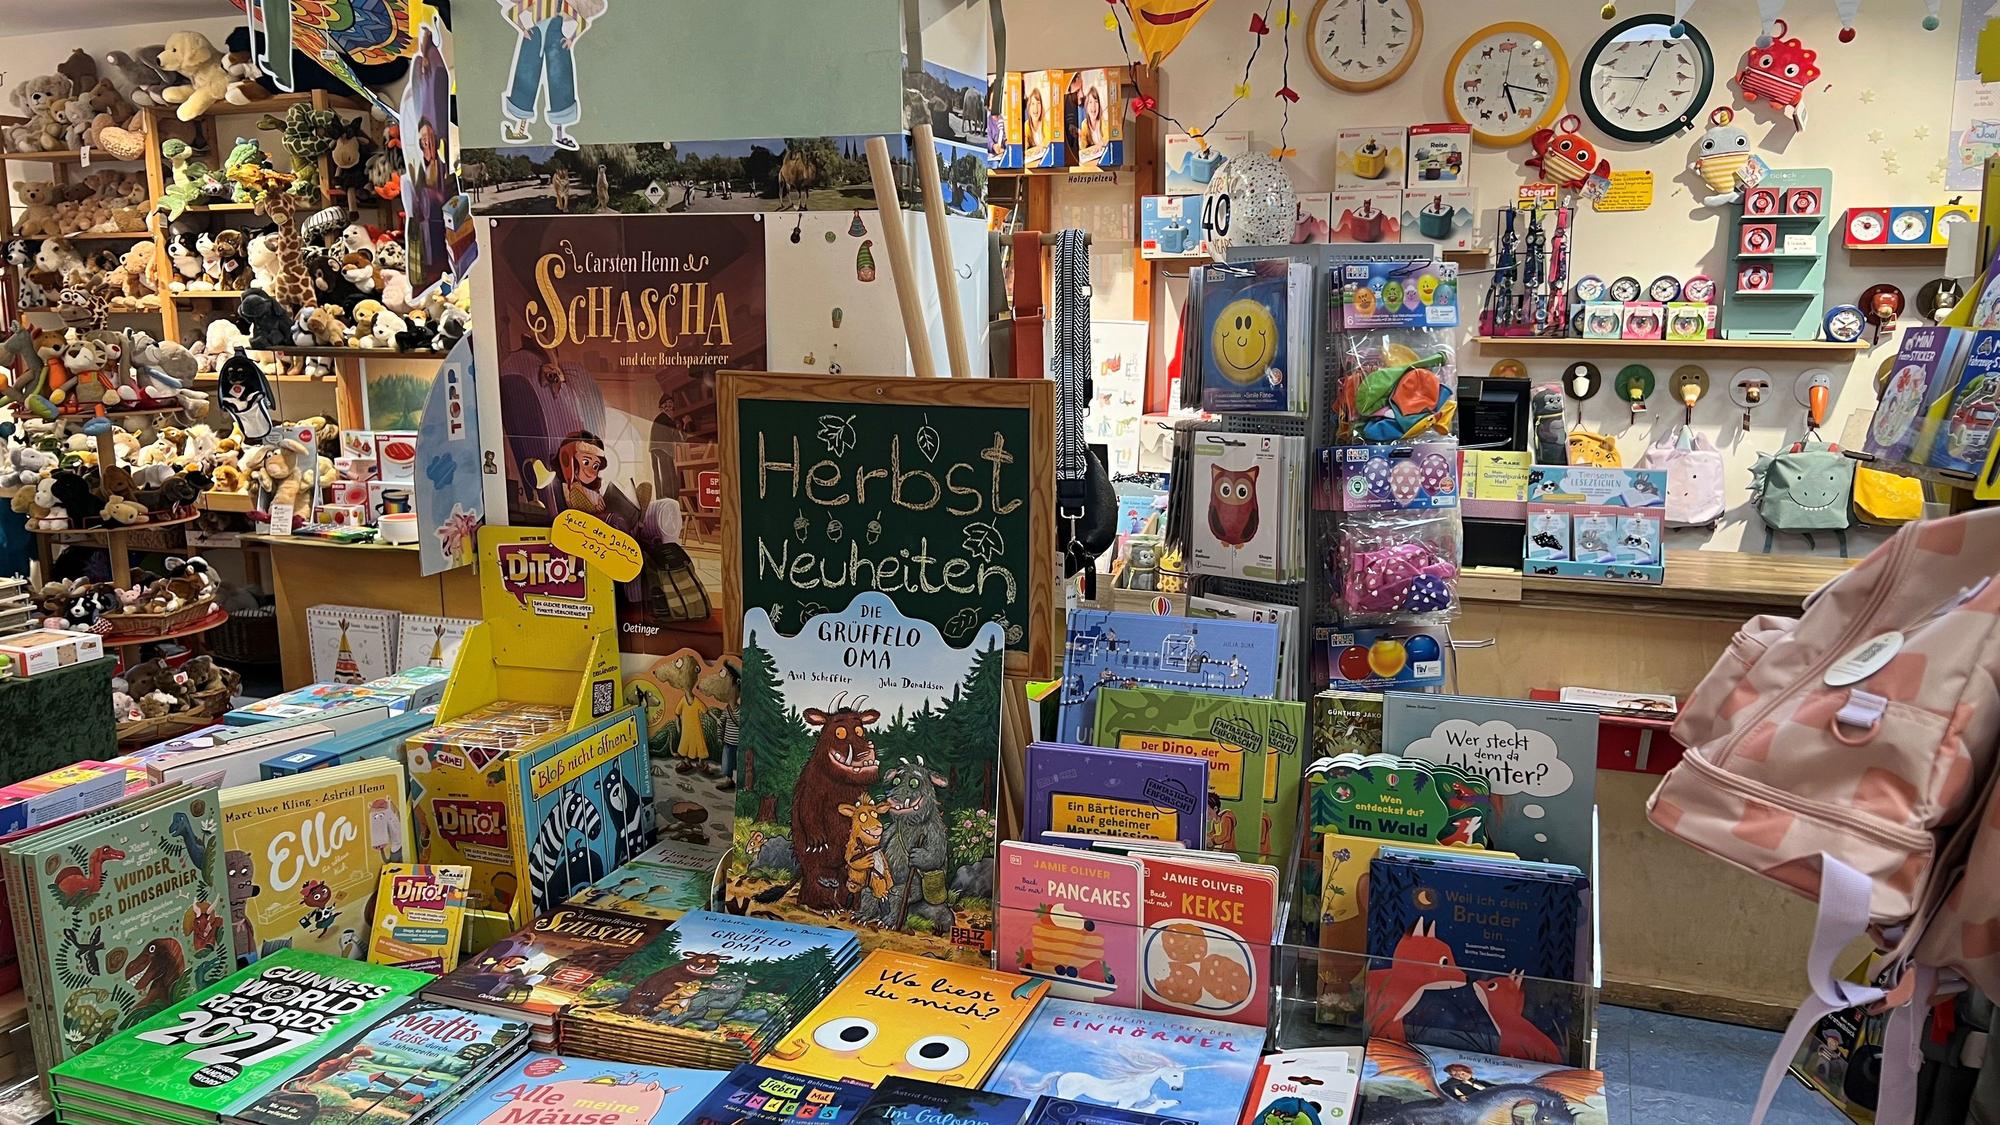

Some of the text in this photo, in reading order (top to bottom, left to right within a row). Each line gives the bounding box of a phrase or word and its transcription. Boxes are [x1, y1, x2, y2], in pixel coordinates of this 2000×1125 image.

[1430, 141, 1449, 149] Reise
[1068, 173, 1117, 185] Holzspielzeu
[1520, 187, 1556, 198] Scout
[1202, 193, 1231, 243] 40
[585, 250, 680, 274] Carsten Henn
[619, 352, 729, 369] und der Buchspazierer
[447, 368, 463, 435] TOPP
[759, 430, 1023, 516] Herbst
[1578, 471, 1615, 480] Tierische
[1570, 479, 1622, 489] LESEZEICHEN
[581, 540, 606, 559] 2026
[593, 527, 606, 540] des
[610, 535, 639, 558] Jahres
[758, 537, 1017, 605] Neuheiten
[860, 604, 882, 619] DIE
[623, 622, 660, 636] Oetinger
[818, 621, 921, 648] GRÜFFELO
[843, 647, 891, 669] OMA
[787, 671, 853, 685] Axel Scheffler
[878, 676, 945, 692] Julia Donaldson
[1327, 708, 1382, 719] GÜNTHER JAKO
[1213, 727, 1257, 750] ERFORSCHT
[1216, 720, 1260, 743] FANTASTISCH
[1446, 730, 1529, 750] Wer steckt
[538, 723, 633, 789] Bloß nicht öffnen!
[1141, 741, 1220, 758] Der Dino, der
[1474, 748, 1519, 761] denn da
[225, 784, 385, 823] Marc-Uwe Kling Astrid Henn
[1146, 788, 1191, 813] ERFORSCHT
[1148, 781, 1195, 805] FANTASTISCH
[1379, 795, 1402, 806] Wen
[1068, 801, 1159, 821] Ein Bärtierchen
[1355, 802, 1425, 818] entdeckst du?
[1066, 825, 1160, 840] Mars-Mission
[1076, 815, 1151, 831] auf geheimer
[1349, 815, 1428, 839] Im Wald
[267, 811, 358, 892] Ella
[113, 857, 176, 893] WUNDER
[1033, 860, 1111, 879] JAMIE OLIVER
[1150, 889, 1167, 899] Back
[1162, 872, 1244, 895] JAMIE OLIVER
[1047, 880, 1131, 909] PANCAKES
[1477, 895, 1495, 906] ich
[1500, 898, 1528, 911] dein
[88, 904, 114, 926] DER
[1181, 893, 1245, 925] KEKSE
[1454, 904, 1521, 928] Bruder
[951, 928, 985, 940] BELTZ
[958, 937, 985, 949] Gelberg
[1483, 928, 1503, 940] bin
[722, 941, 760, 952] OMA
[262, 965, 392, 1000] GUINNESS
[879, 969, 921, 987] Wo
[931, 978, 996, 1002] liest
[232, 978, 365, 1016] WORLD
[864, 983, 1000, 1020] du mich?
[199, 993, 341, 1035] RECORDS
[134, 1010, 319, 1067] 2027
[395, 1014, 482, 1043] Mattis
[1052, 1016, 1241, 1053] EINHÖRNER
[388, 1029, 448, 1052] Reise durch
[496, 1083, 565, 1105] Alle
[894, 1088, 948, 1104] Astrid Frank
[1271, 1083, 1298, 1093] goki
[499, 1108, 620, 1125] Mäuse
[573, 1098, 640, 1114] meine
[883, 1106, 904, 1120] Im
